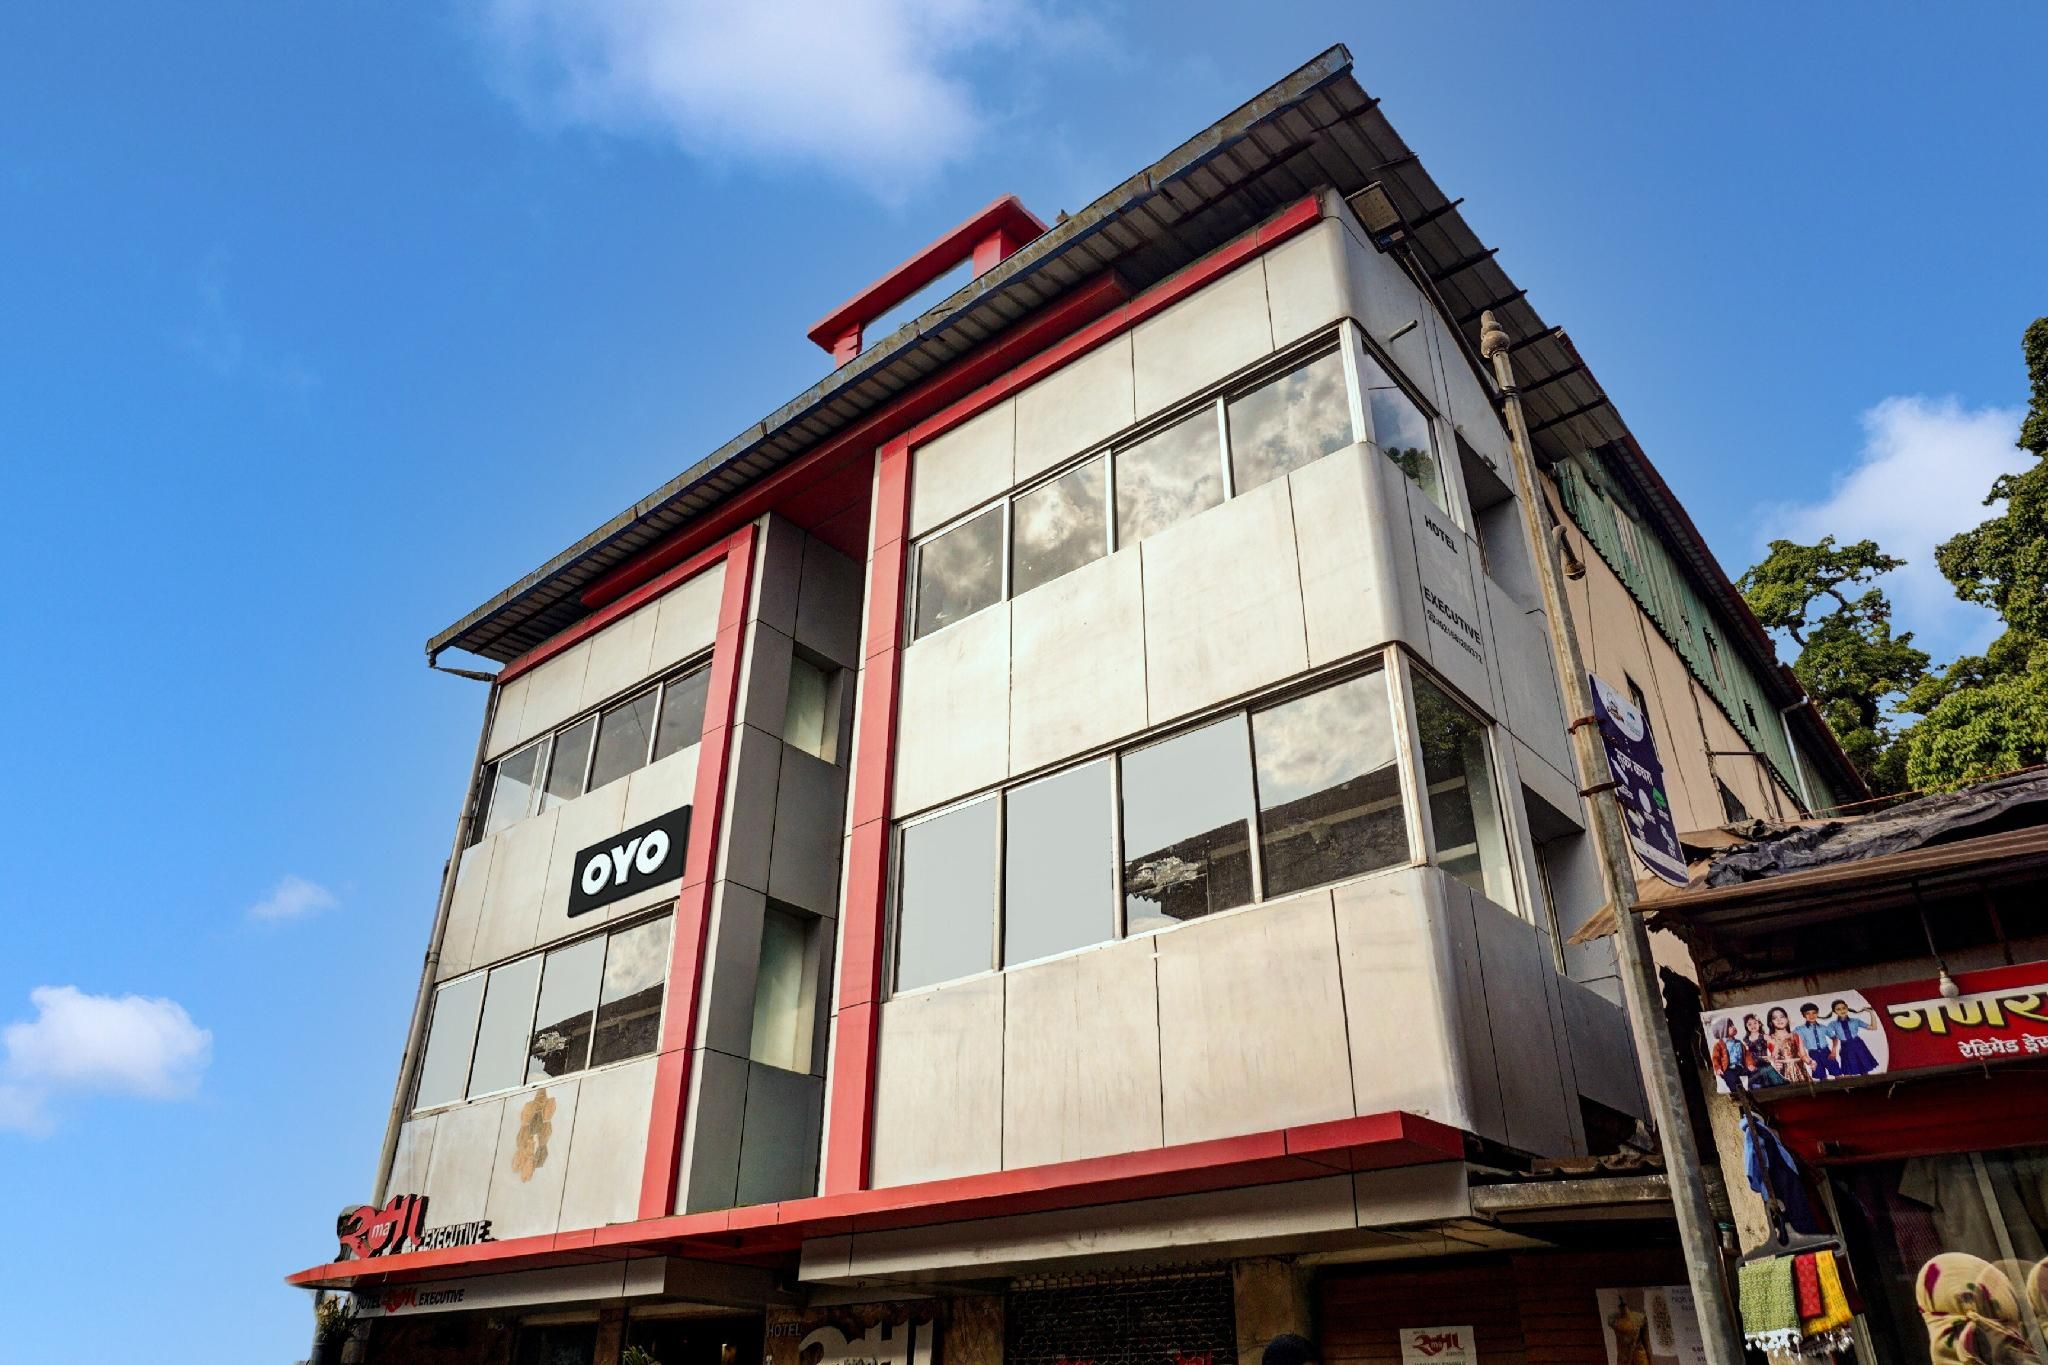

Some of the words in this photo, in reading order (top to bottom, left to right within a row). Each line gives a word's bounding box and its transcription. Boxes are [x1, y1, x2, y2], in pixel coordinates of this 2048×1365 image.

[1424, 514, 1458, 554] HOTEL
[1424, 586, 1482, 645] EXECUTIVE
[581, 828, 671, 896] OYO
[1887, 983, 2048, 1034] गणर
[424, 1220, 490, 1252] EXECUTIVE
[356, 1294, 380, 1309] HOTEL
[418, 1288, 465, 1306] EXECUTIVE
[766, 1321, 802, 1338] HOTEL
